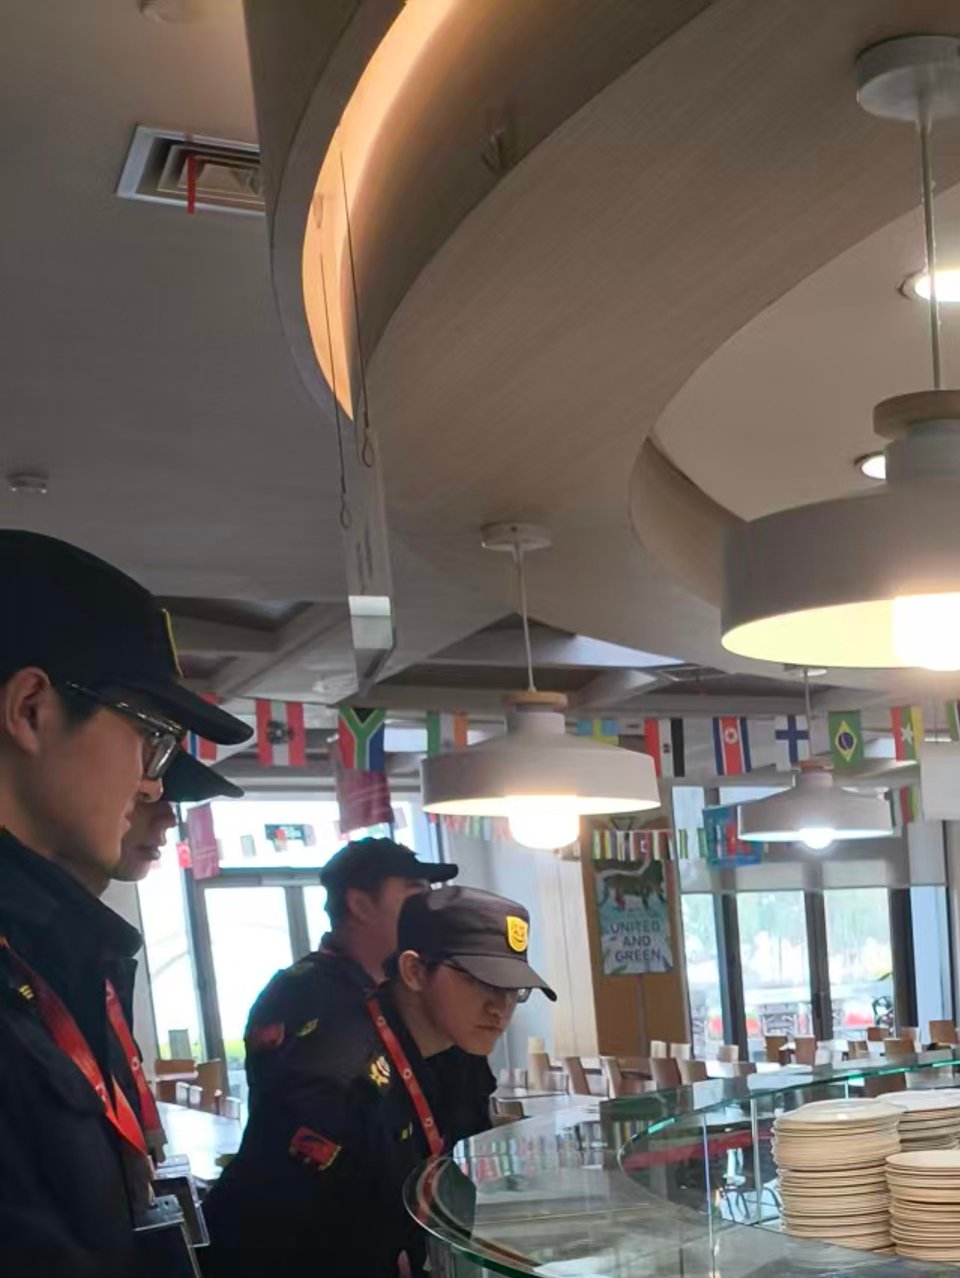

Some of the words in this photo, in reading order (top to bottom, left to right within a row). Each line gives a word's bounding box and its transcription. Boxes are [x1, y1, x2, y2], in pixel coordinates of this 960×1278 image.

[610, 920, 660, 934] UNITED
[623, 935, 651, 947] AND
[615, 948, 661, 962] GREEN
